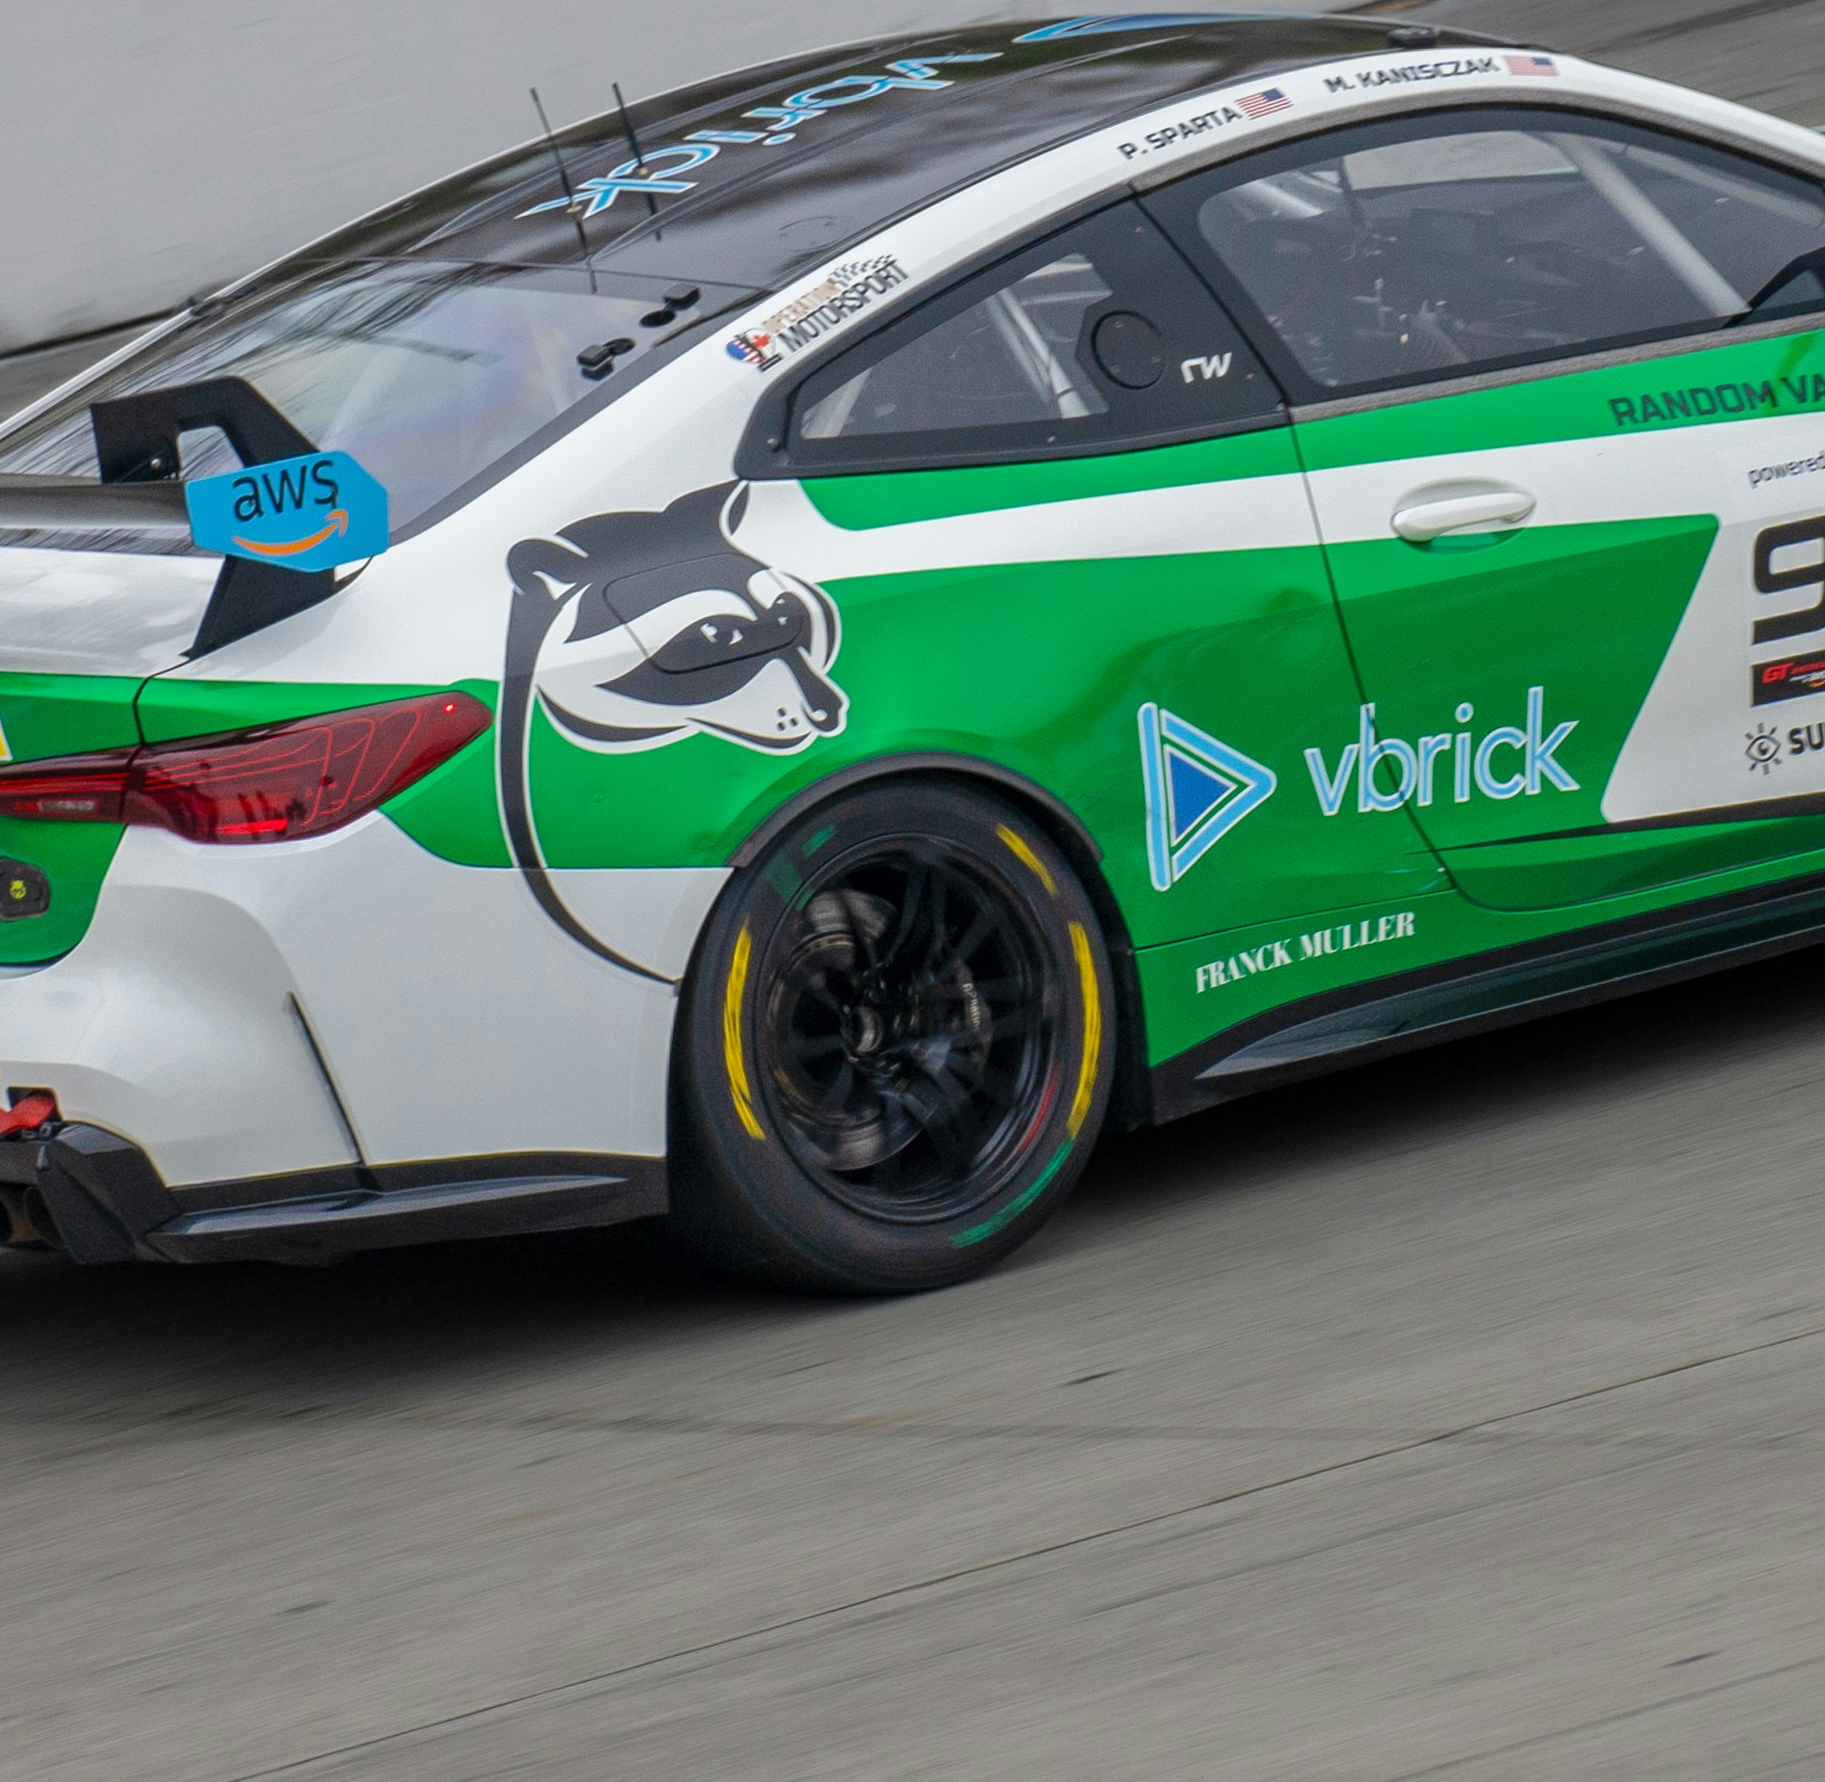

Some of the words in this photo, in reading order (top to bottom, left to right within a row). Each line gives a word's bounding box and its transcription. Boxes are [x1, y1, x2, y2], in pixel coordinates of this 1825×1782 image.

[1324, 75, 1355, 94] M.
[1361, 56, 1500, 89] KANISCZAK
[512, 51, 1004, 219] vbrick
[1117, 141, 1148, 161] P.
[1149, 106, 1243, 152] SPARTA
[778, 262, 910, 352] MOTORSPORT
[1608, 379, 1779, 427] RANDOM
[232, 458, 339, 522] aws
[1304, 685, 1581, 817] vbrick
[1196, 937, 1293, 994] FRANCK
[1299, 911, 1416, 961] MULLER
